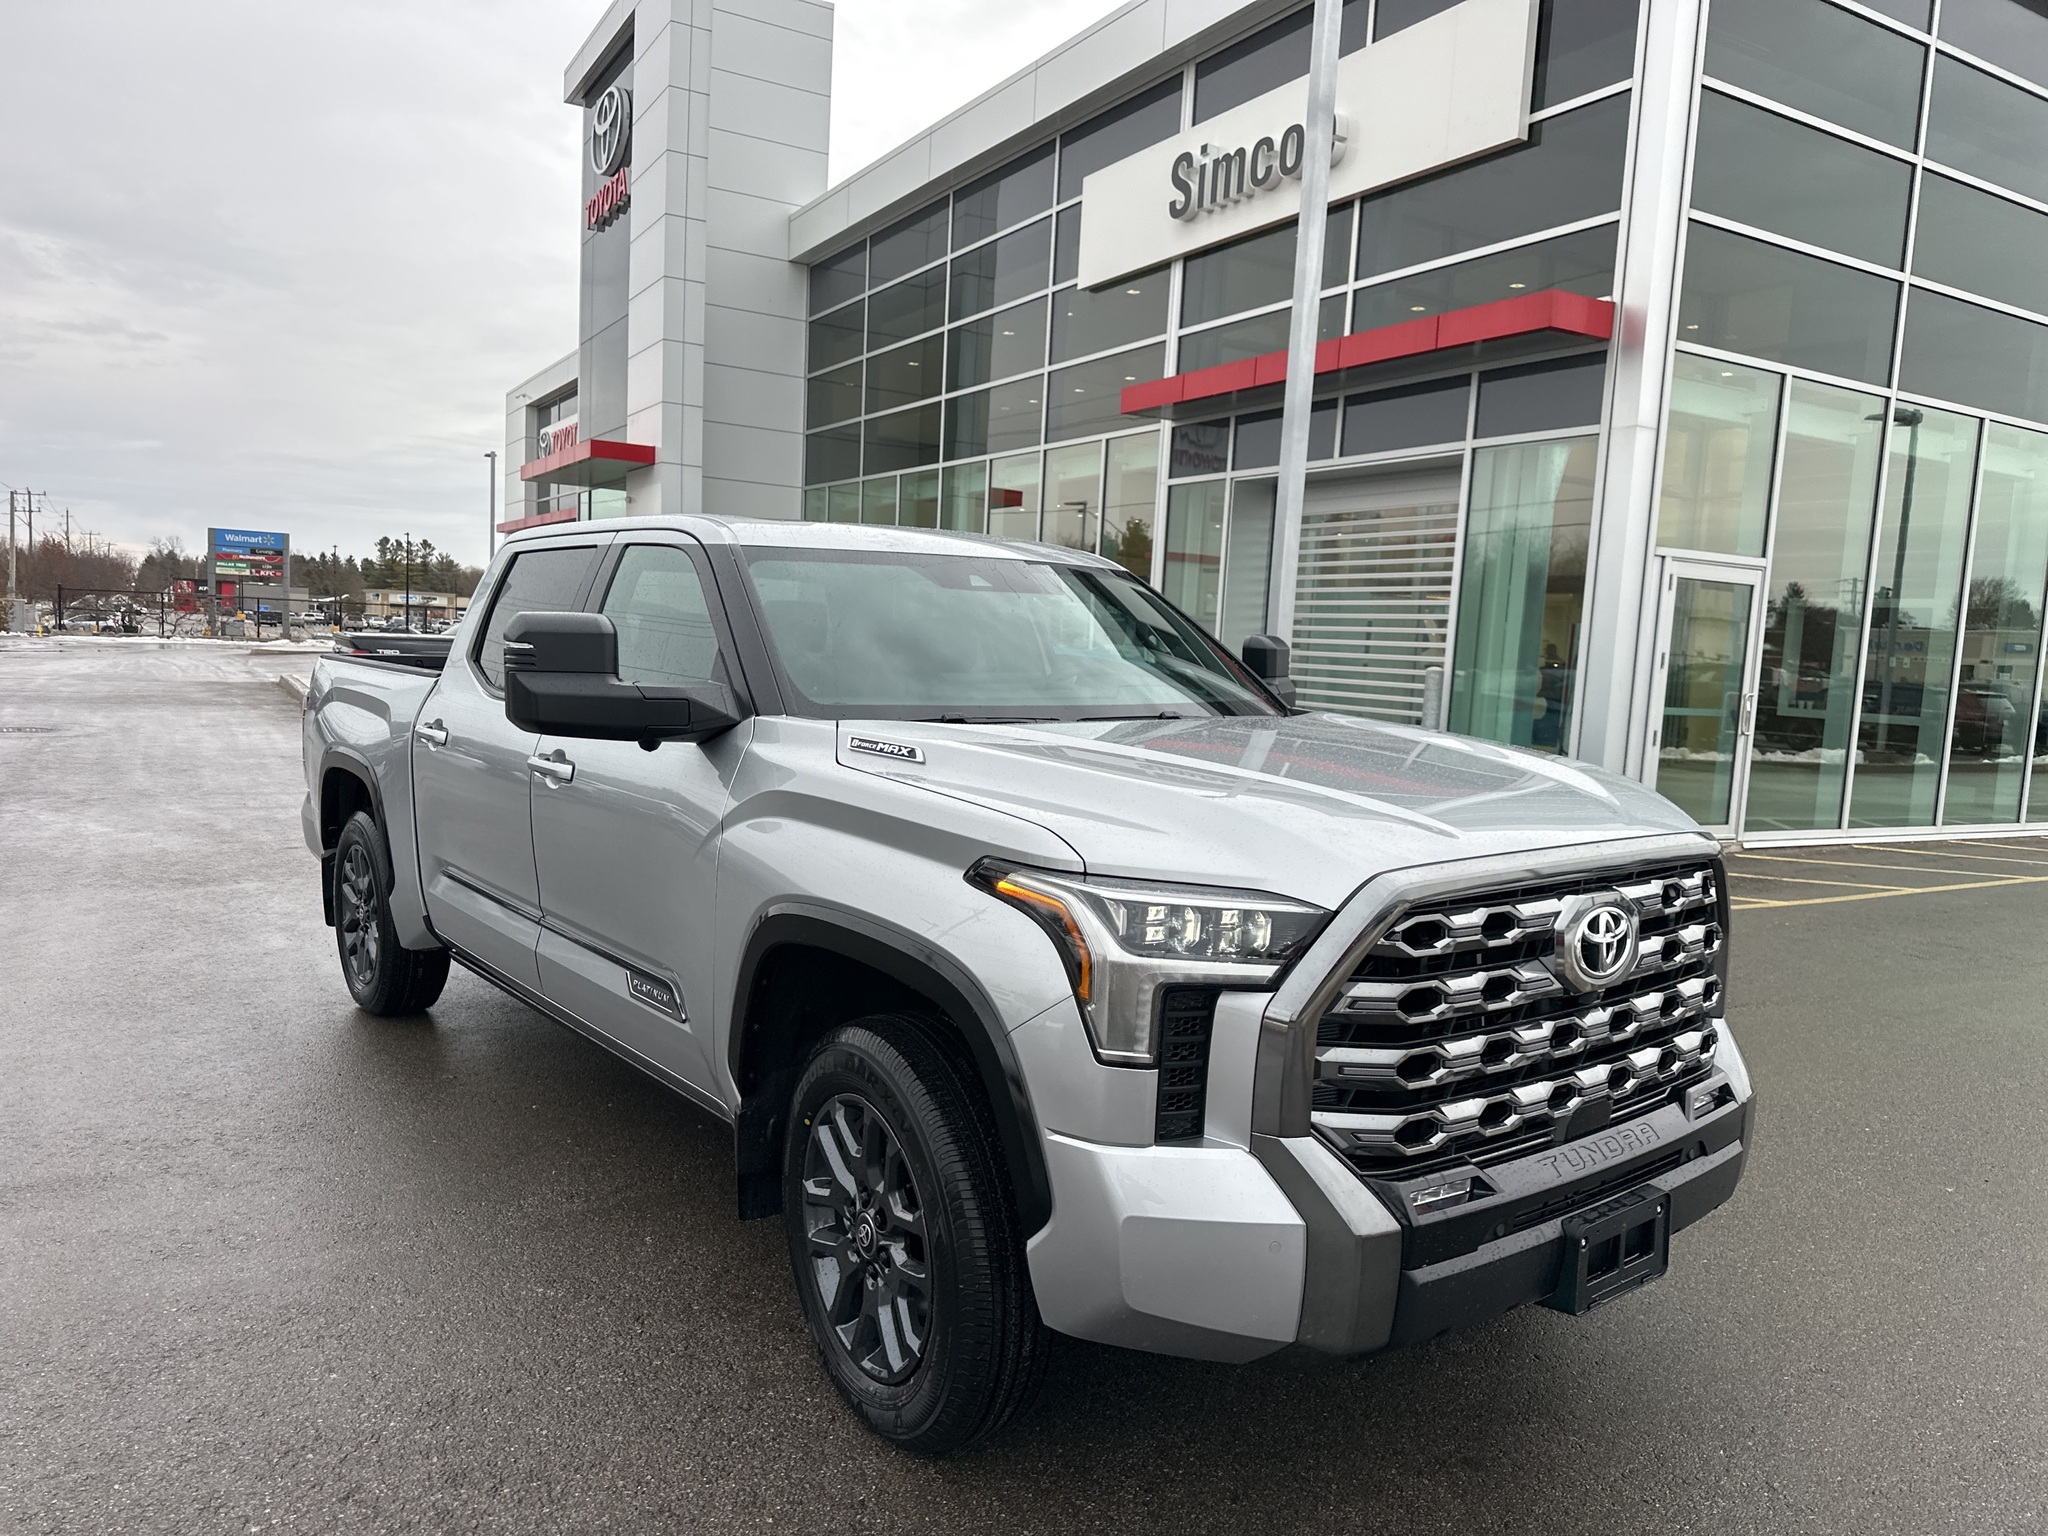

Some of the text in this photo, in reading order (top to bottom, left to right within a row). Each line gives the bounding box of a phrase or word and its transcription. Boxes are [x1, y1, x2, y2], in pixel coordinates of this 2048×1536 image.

[1169, 113, 1337, 220] Simco
[586, 167, 629, 230] TOYOTA
[551, 422, 578, 452] TOYOT
[225, 533, 262, 543] Walmart
[876, 742, 911, 757] MAX
[632, 979, 670, 1003] PLATINUM
[1536, 1122, 1661, 1178] TUNDRA
